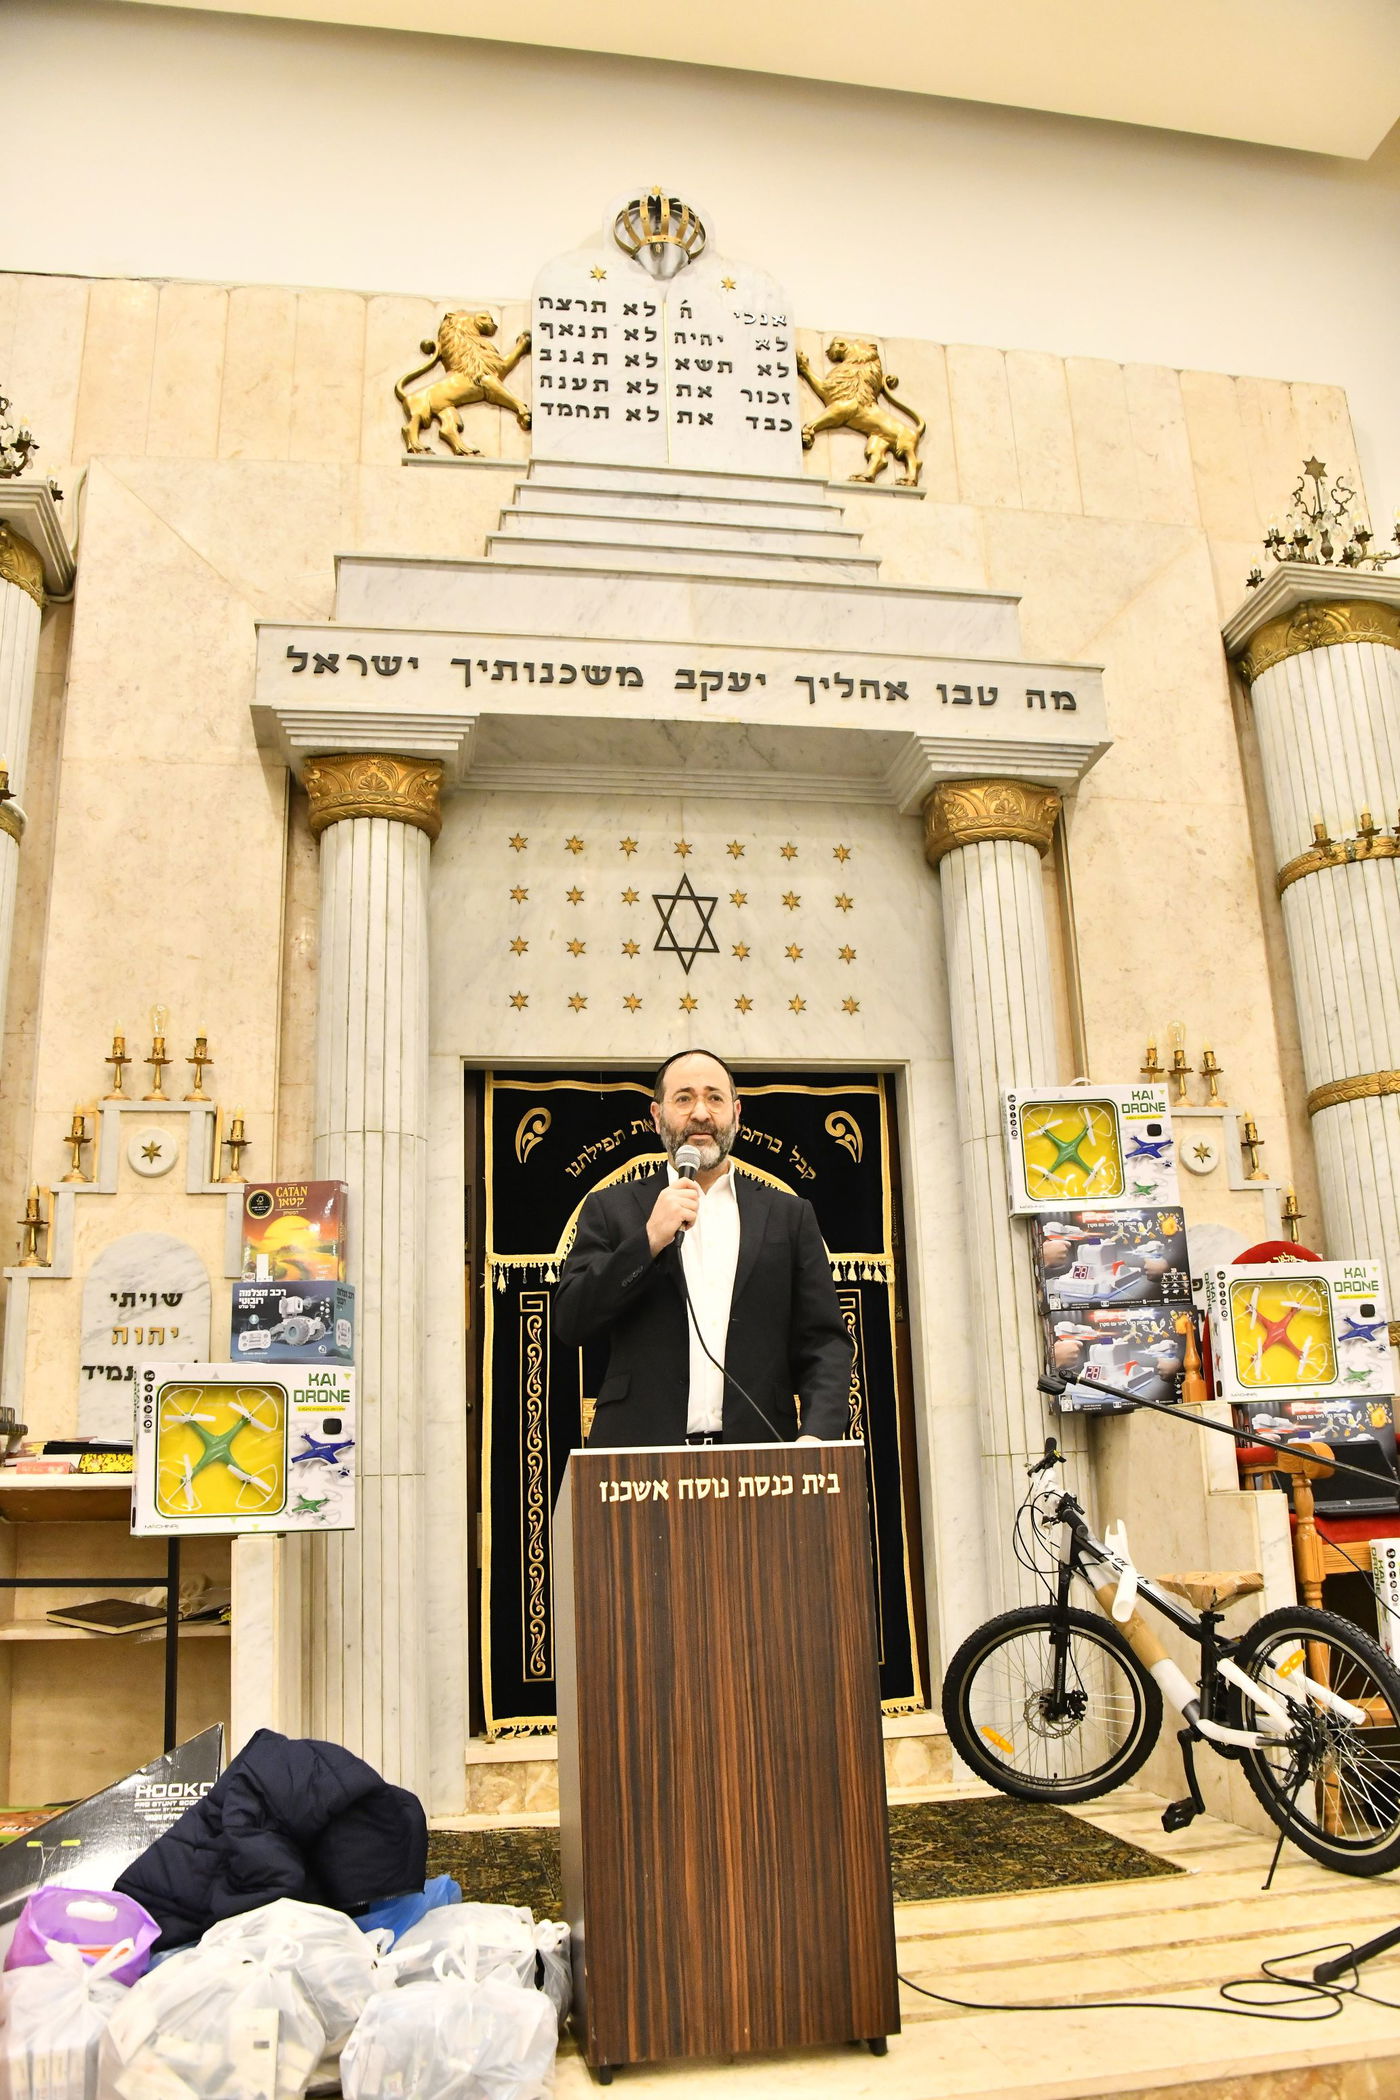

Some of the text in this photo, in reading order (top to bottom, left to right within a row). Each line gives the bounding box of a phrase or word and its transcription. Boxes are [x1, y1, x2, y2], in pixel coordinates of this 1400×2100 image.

[538, 296, 657, 318] לא תרצח
[733, 310, 787, 327] אנכי
[538, 322, 657, 343] לא תנאף
[673, 331, 788, 353] לא יהיה
[539, 348, 658, 369] לא תגנב
[674, 357, 790, 379] לא תשא
[539, 374, 659, 396] לא תענה
[675, 383, 791, 406] זכור את
[539, 402, 660, 423] לא תחמד
[676, 410, 793, 433] כבד את
[286, 645, 1077, 711] מה טבו אהליך יעקב משכנותיך ישראל
[1131, 1090, 1154, 1100] KAI
[1122, 1102, 1166, 1114] DRONE
[564, 1129, 626, 1177] תפילתנו
[789, 1145, 816, 1179] קבל
[276, 1186, 308, 1197] CATAN
[279, 1198, 305, 1208] קטאן
[1344, 1267, 1367, 1278] KAI
[239, 1288, 268, 1297] מצלמה
[1334, 1281, 1379, 1293] DRONE
[110, 1292, 183, 1308] שויתי
[239, 1297, 264, 1305] רובוטי
[112, 1326, 179, 1346] יהוה
[309, 1373, 336, 1386] KAI
[294, 1389, 350, 1403] DRONE
[599, 1472, 841, 1503] בית כנסת נוסח אשכנז
[1371, 1547, 1381, 1595] DRONE
